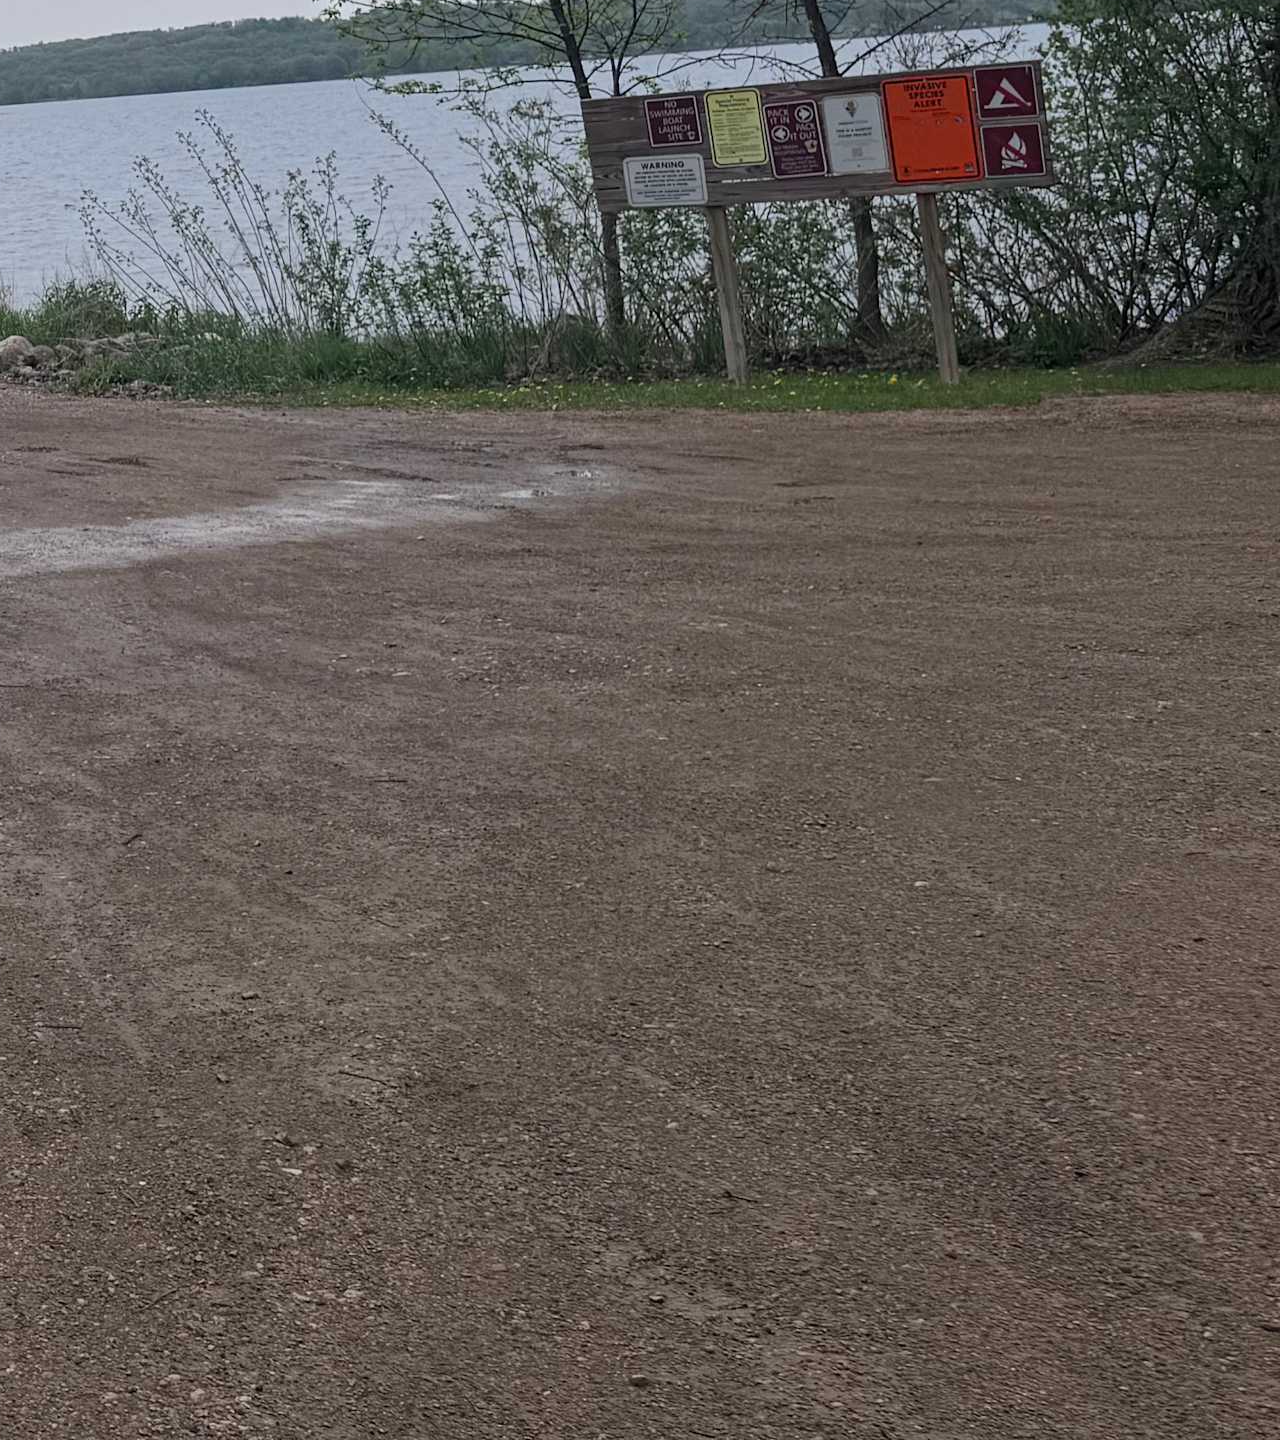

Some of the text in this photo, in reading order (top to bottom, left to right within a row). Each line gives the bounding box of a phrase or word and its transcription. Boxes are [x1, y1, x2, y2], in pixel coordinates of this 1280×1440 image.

[903, 81, 947, 92] INVASIVE
[908, 90, 944, 100] SPECIES
[664, 101, 677, 109] NO
[913, 98, 942, 108] ALERT
[650, 107, 694, 118] SWIMMING
[768, 109, 789, 118] PACK
[663, 116, 682, 125] BOAT
[770, 116, 790, 125] IT IN
[658, 124, 691, 134] LAUNCH
[795, 122, 816, 131] PACK
[668, 132, 684, 141] SITE
[790, 130, 817, 140] IT OUT
[641, 160, 684, 169] WARNING
